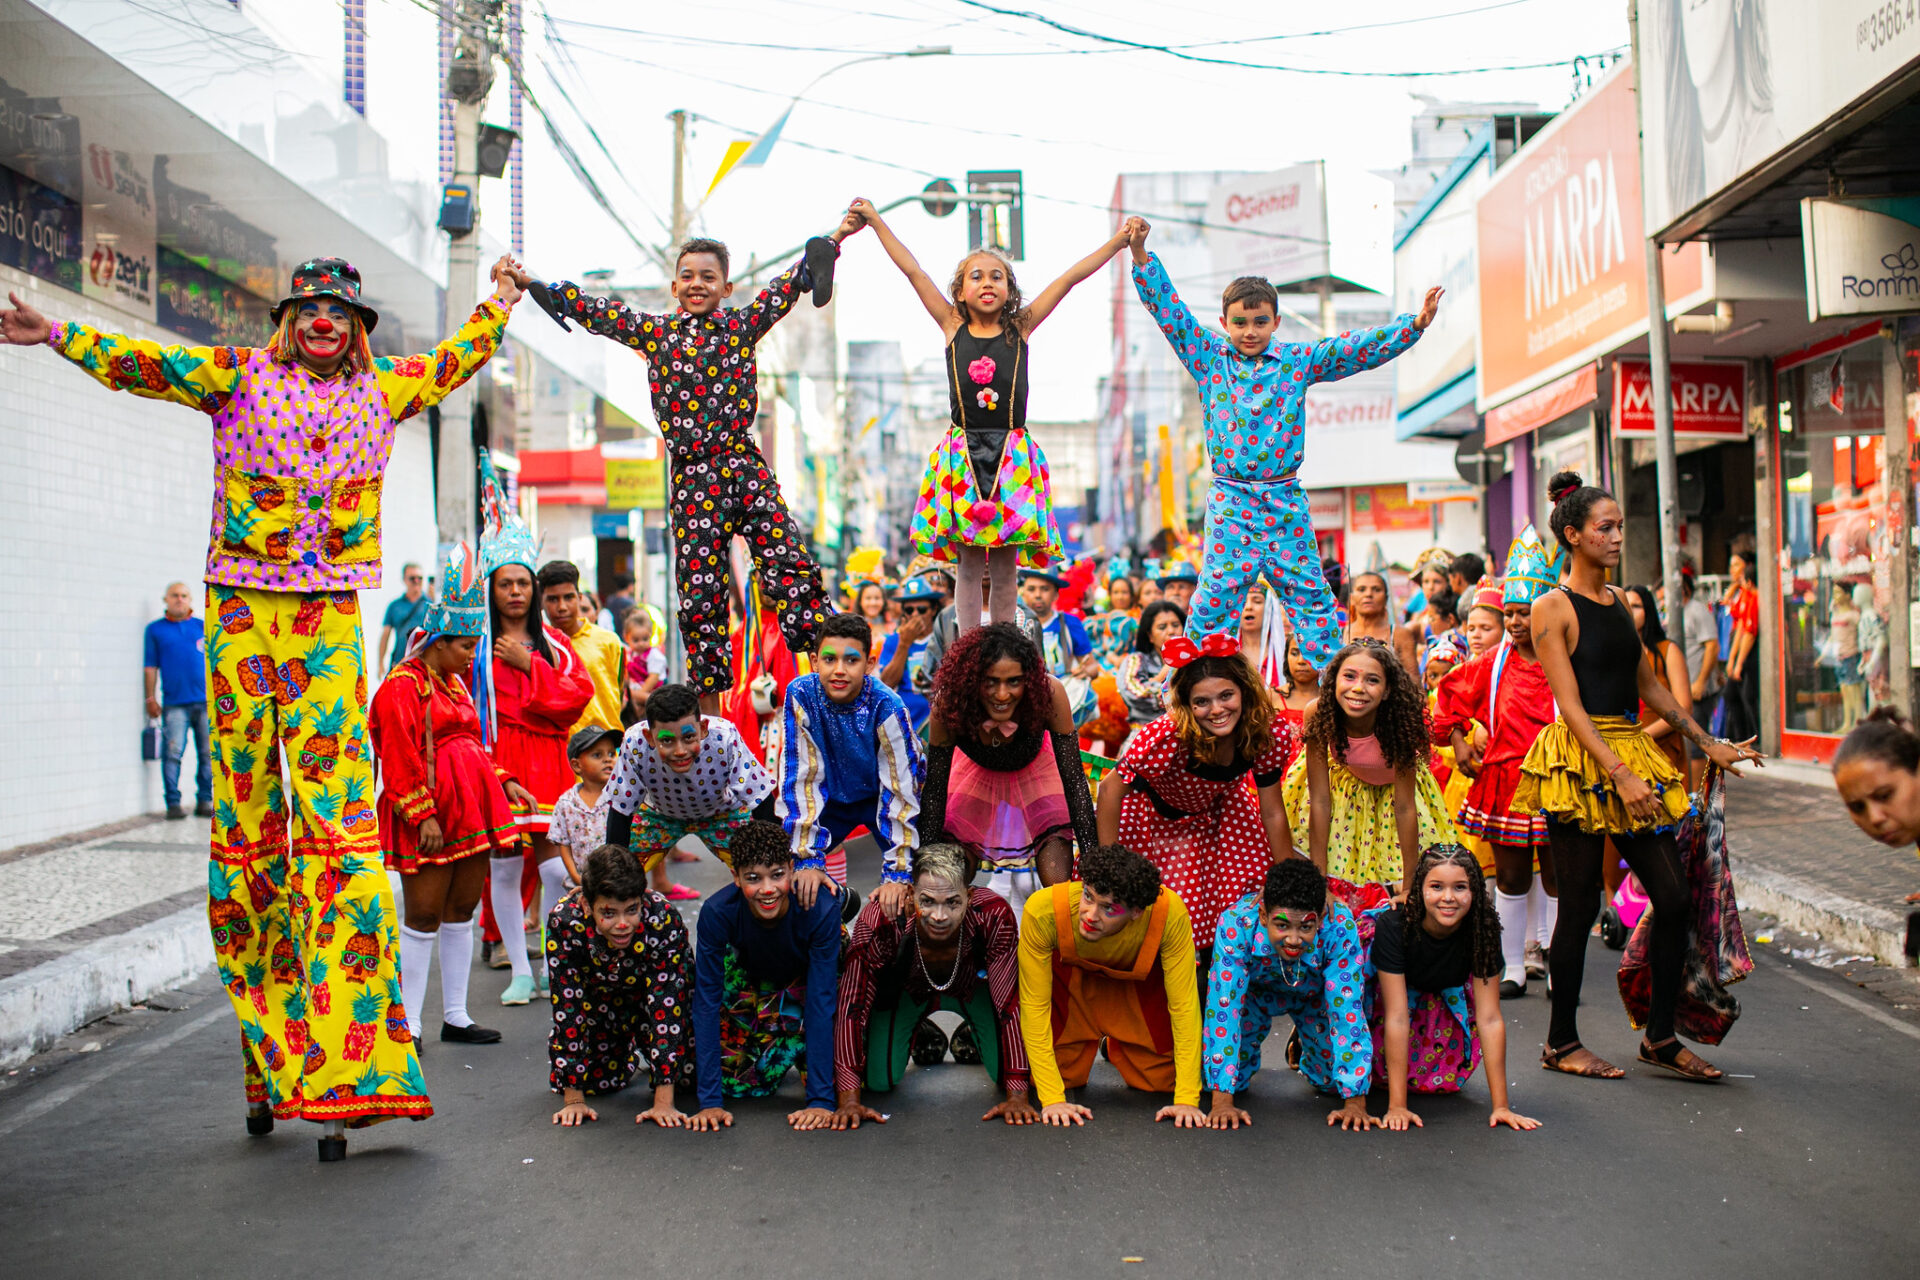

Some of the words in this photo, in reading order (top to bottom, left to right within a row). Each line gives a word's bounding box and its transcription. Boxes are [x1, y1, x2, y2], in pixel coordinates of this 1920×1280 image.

[32, 220, 67, 263] aqui
[1524, 148, 1626, 321] MARPA
[1842, 275, 1920, 299] Romm
